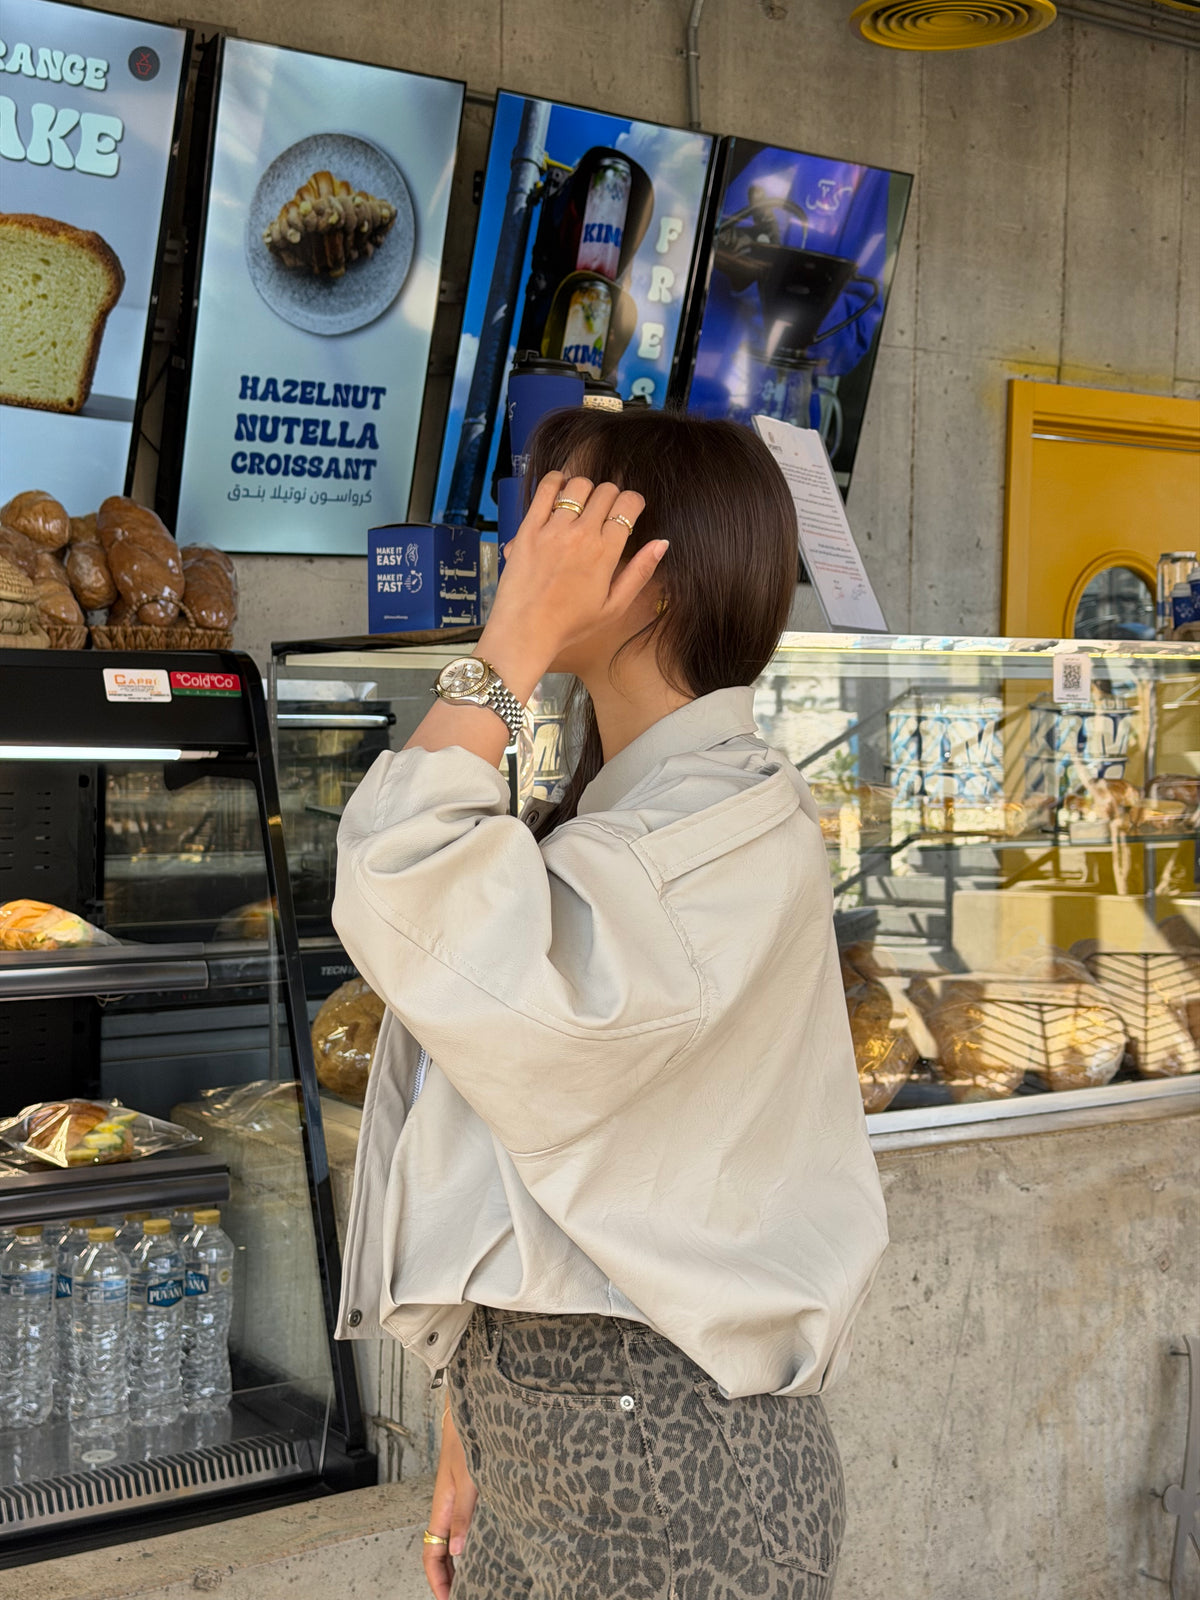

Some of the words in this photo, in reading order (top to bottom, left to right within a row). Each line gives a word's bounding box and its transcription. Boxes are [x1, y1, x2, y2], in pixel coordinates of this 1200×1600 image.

[0, 40, 108, 91] ANGE
[239, 375, 387, 411] HAZELNUT
[234, 413, 379, 450] NUTELLA
[231, 451, 377, 481] CROISSANT
[269, 484, 307, 504] نوتيلا
[376, 546, 395, 555] MAKE
[396, 546, 403, 554] IT
[376, 555, 402, 566] EASY
[377, 573, 395, 582] MAKE
[396, 573, 403, 581] IT
[377, 582, 403, 593] FAST
